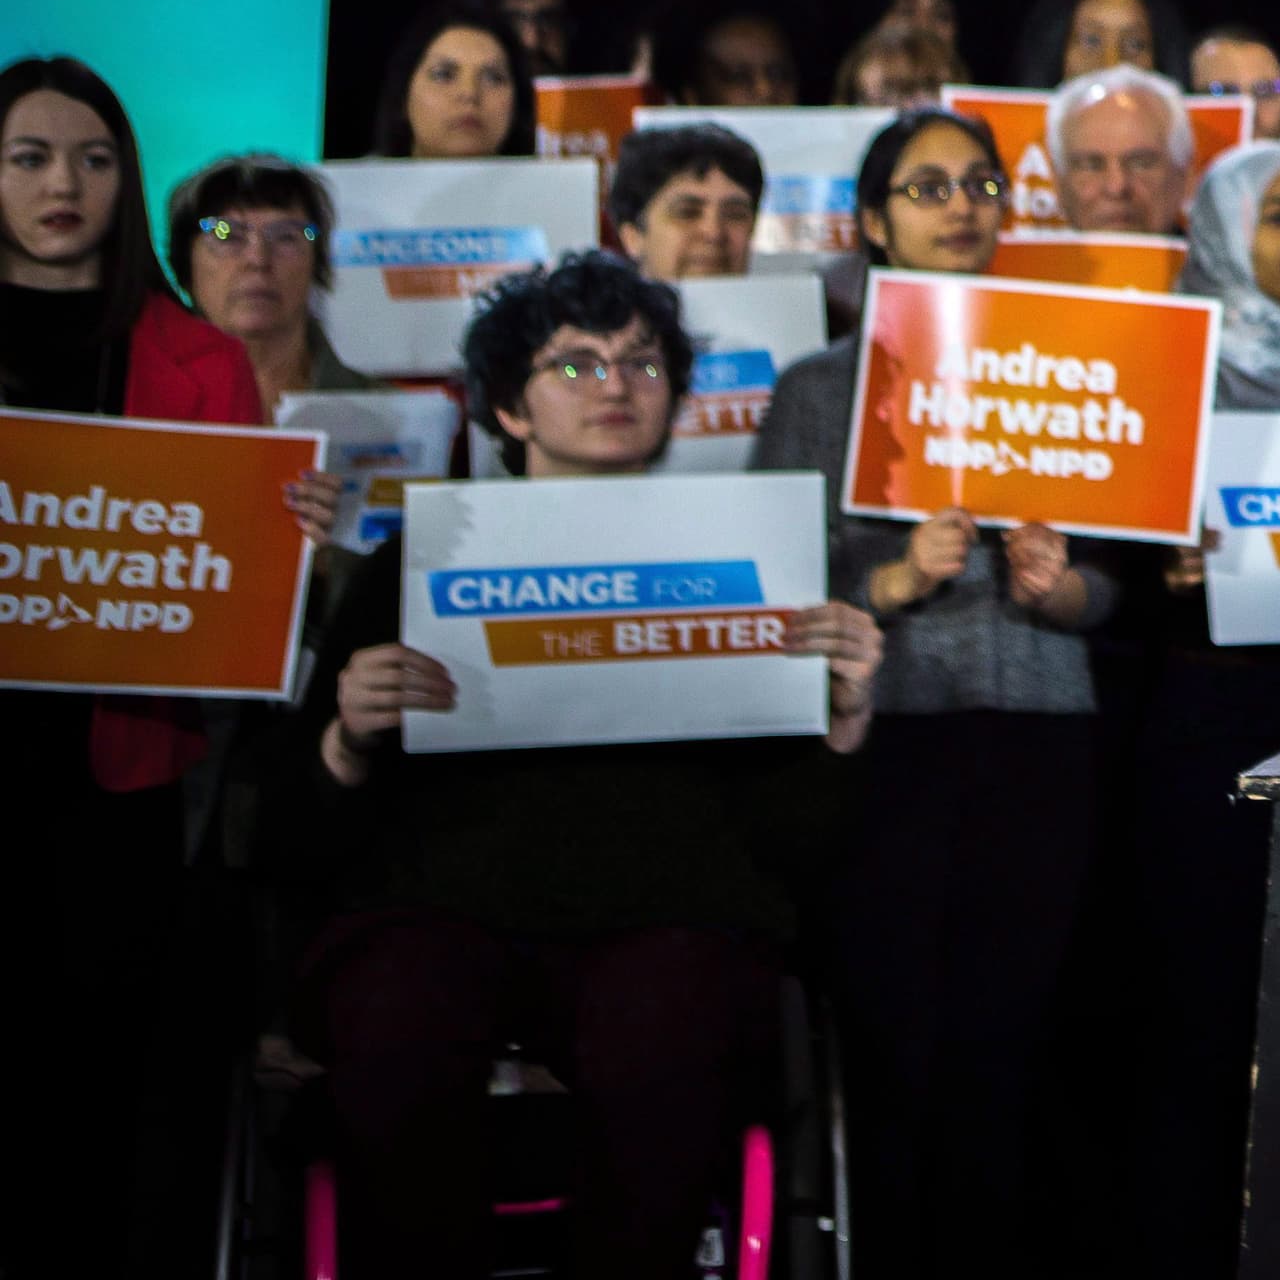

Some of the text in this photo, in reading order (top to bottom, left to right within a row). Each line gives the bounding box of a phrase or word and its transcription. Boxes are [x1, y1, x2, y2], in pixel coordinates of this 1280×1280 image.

[935, 342, 1117, 394] Andrea
[908, 380, 1144, 445] Horwath
[924, 435, 1114, 480] NDP NPD
[0, 541, 232, 592] orwath
[448, 571, 716, 610] CHANGE FOR
[0, 593, 194, 634] DP NPD
[541, 615, 786, 659] THE BETTER
